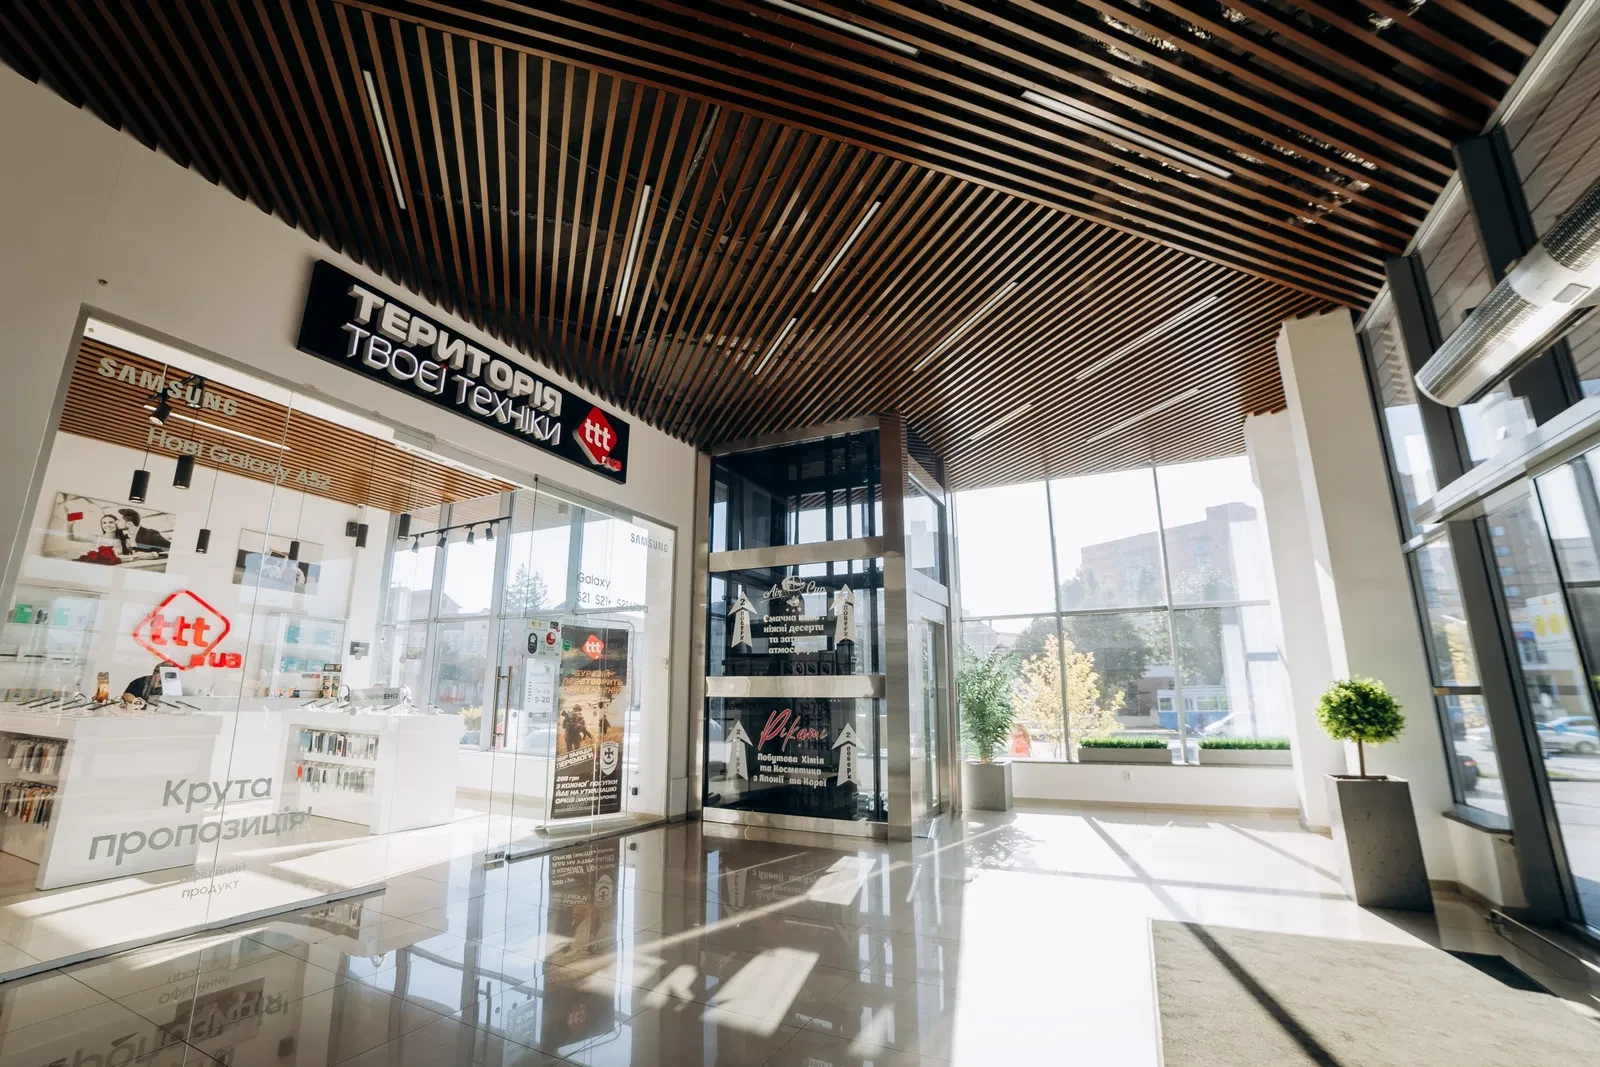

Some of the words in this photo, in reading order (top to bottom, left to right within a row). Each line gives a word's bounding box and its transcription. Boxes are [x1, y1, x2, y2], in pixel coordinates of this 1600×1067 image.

[348, 284, 562, 417] ТЕРИТОРІЯ
[97, 357, 239, 416] SAMSUNG
[584, 418, 611, 451] ttt
[209, 444, 291, 485] Galaxy
[630, 533, 669, 553] SAMSUNG
[577, 572, 611, 591] Galaxy
[576, 591, 590, 603] S21
[740, 598, 745, 606] 2
[763, 614, 796, 623] Смачна
[150, 614, 211, 648] ttt
[763, 624, 787, 633] ніжні
[789, 624, 824, 634] десерти
[586, 641, 601, 653] ttt
[162, 777, 273, 813] Крута
[181, 880, 240, 900] продукт
